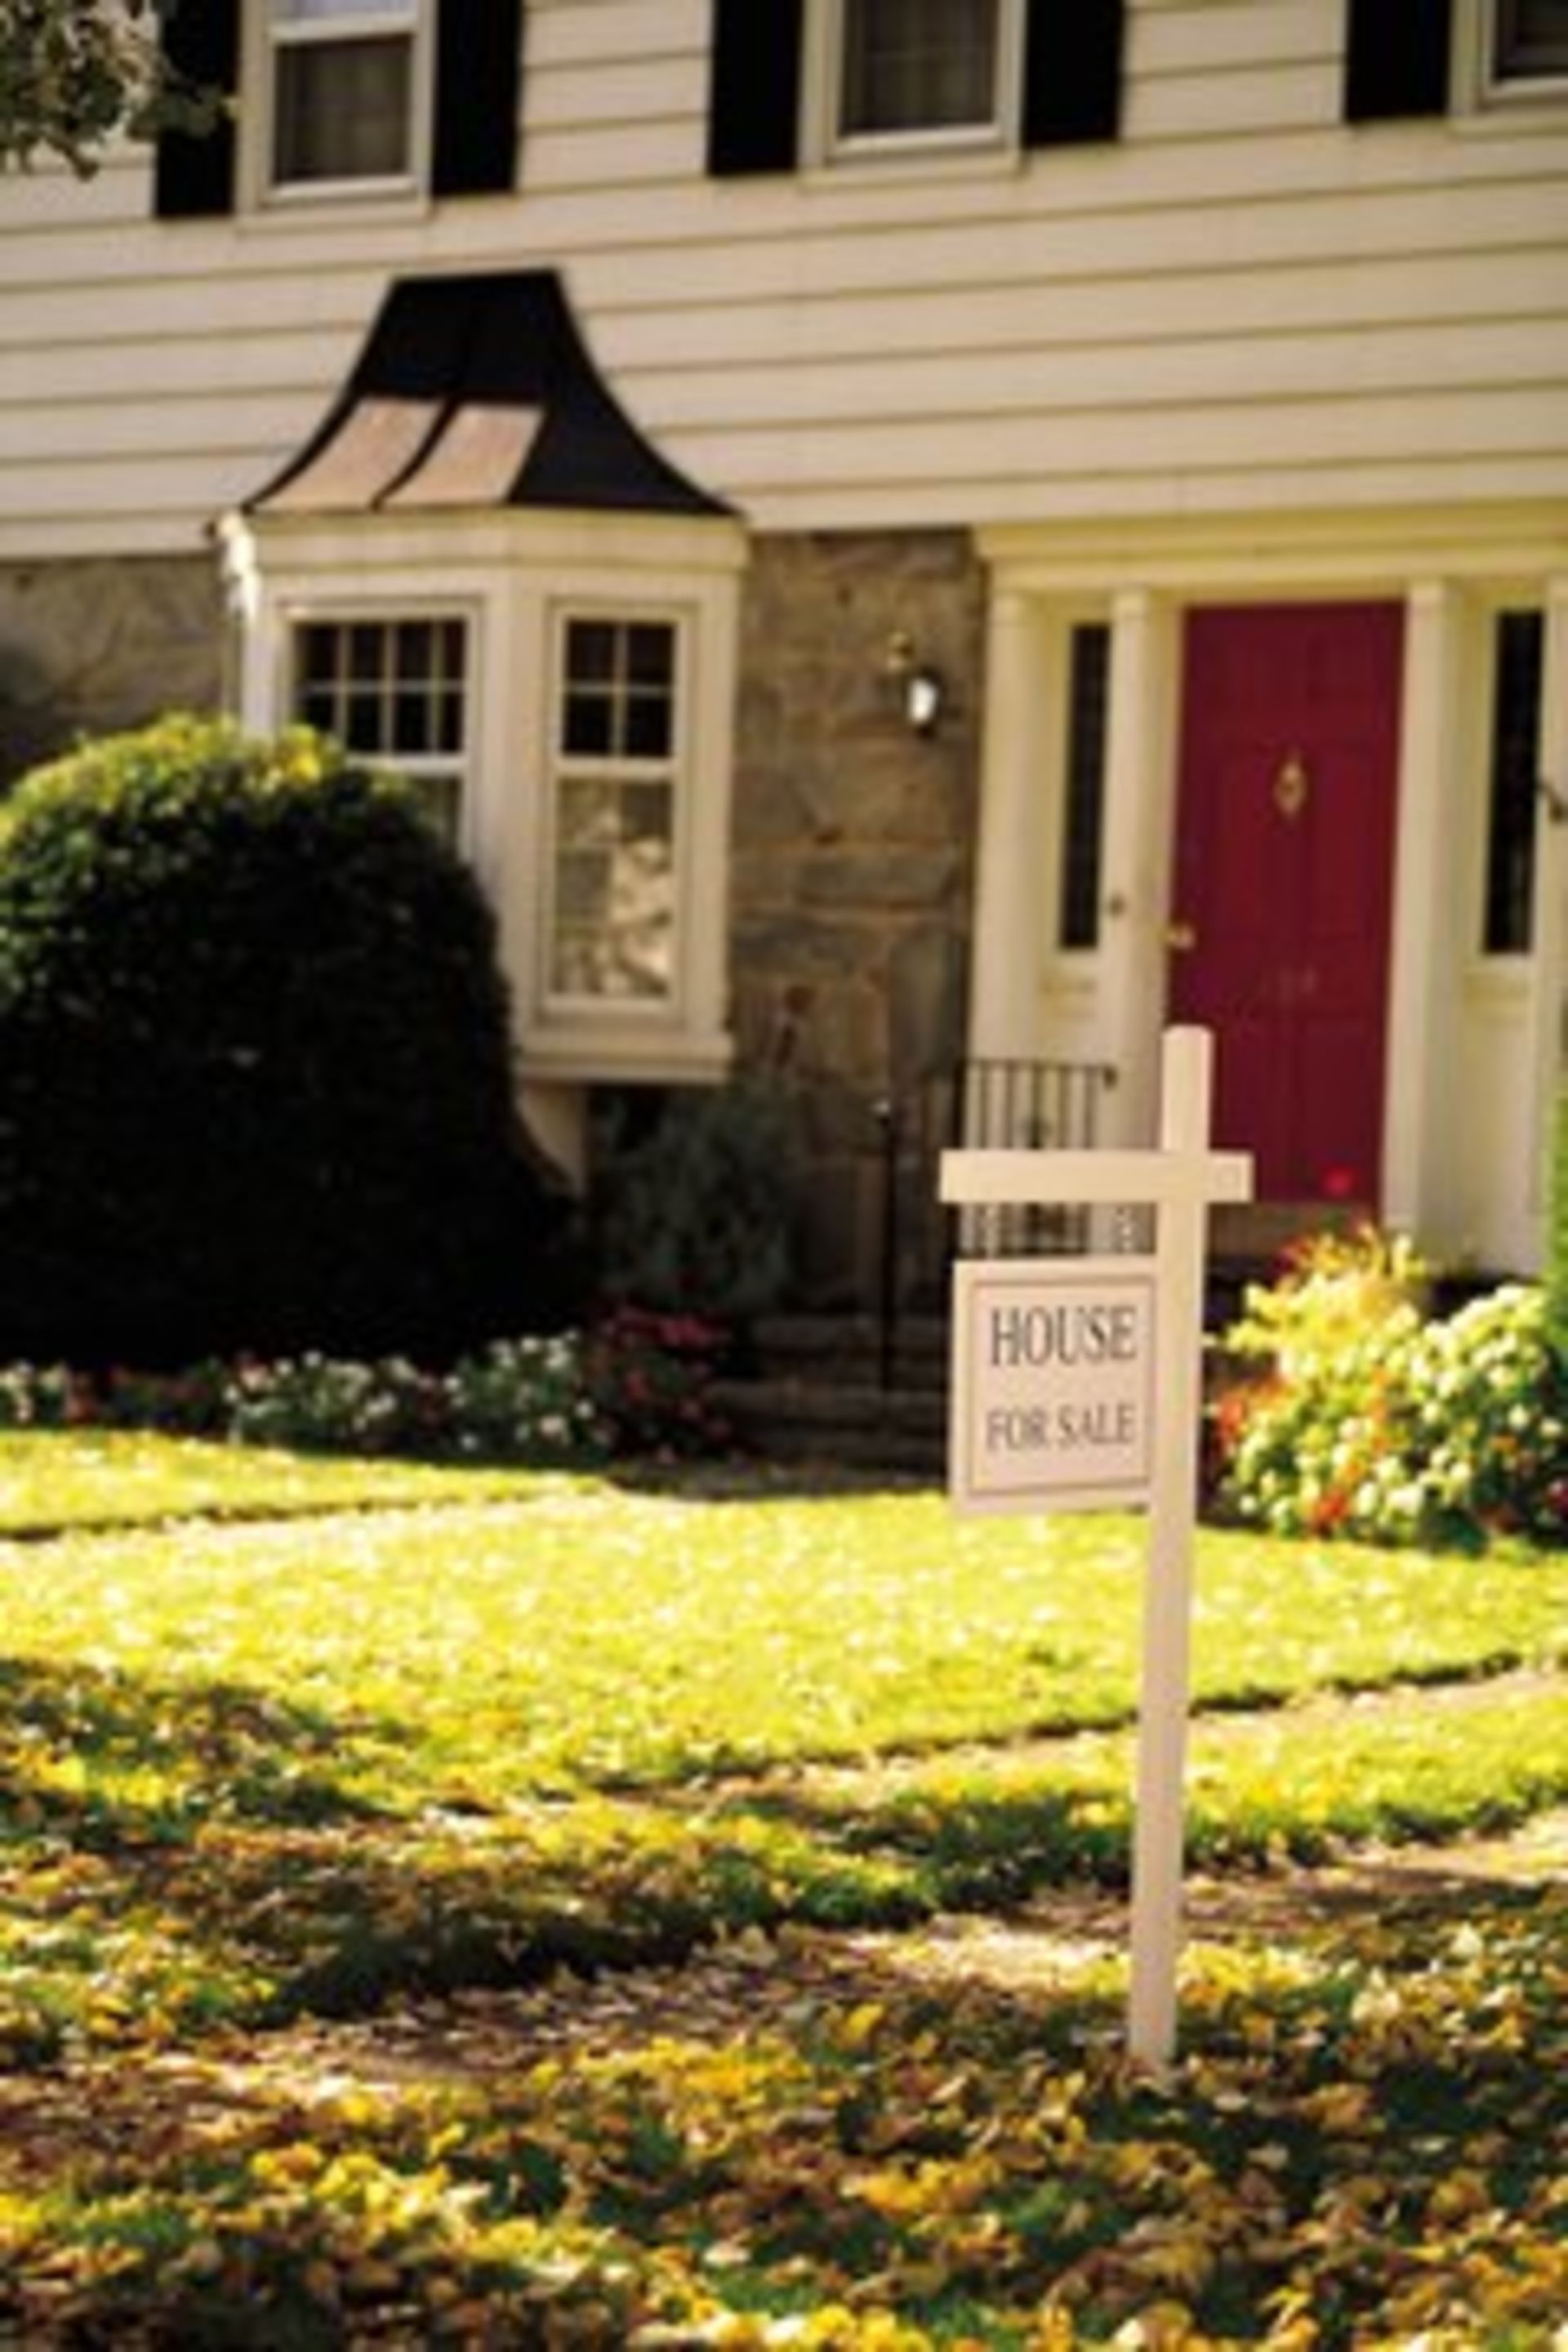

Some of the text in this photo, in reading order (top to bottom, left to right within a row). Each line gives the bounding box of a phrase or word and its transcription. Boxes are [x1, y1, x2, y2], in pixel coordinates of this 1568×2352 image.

[991, 1306, 1137, 1366] HOUSE
[986, 1401, 1136, 1452] FOR SALE
